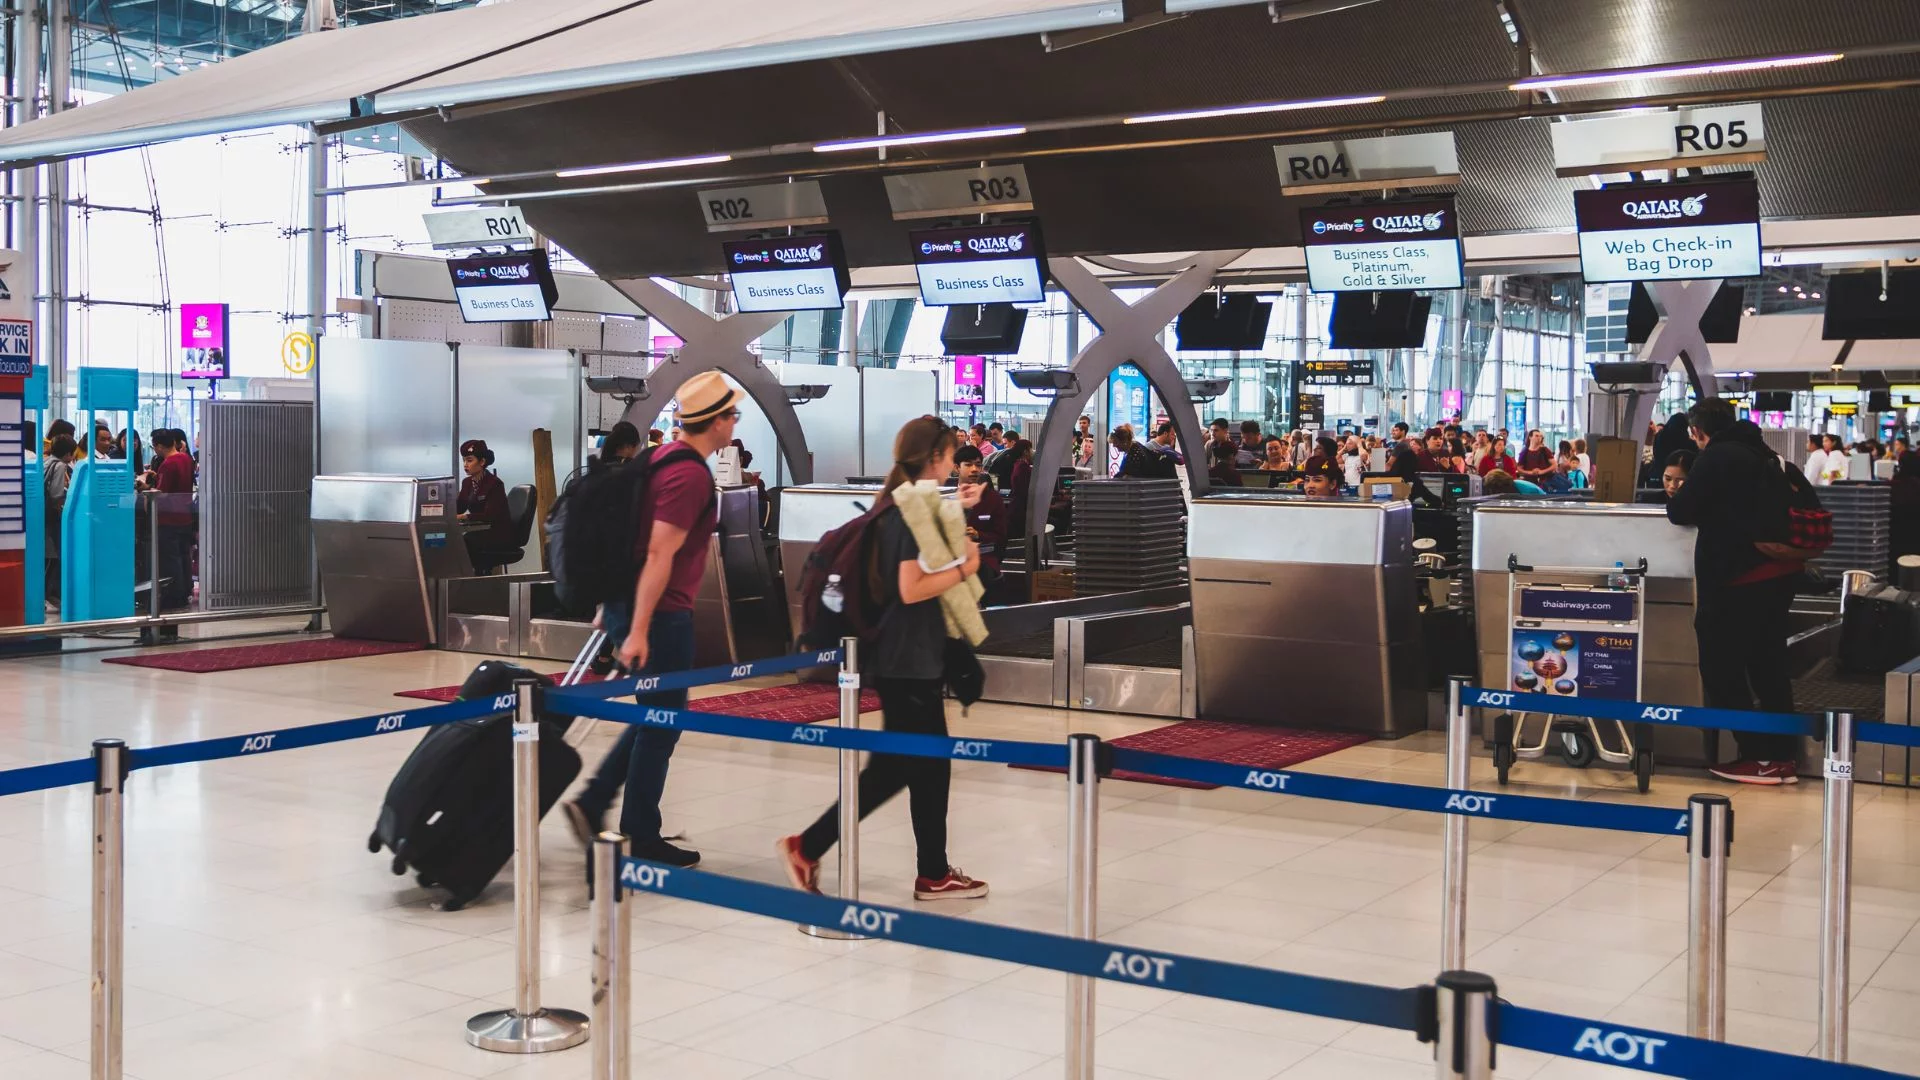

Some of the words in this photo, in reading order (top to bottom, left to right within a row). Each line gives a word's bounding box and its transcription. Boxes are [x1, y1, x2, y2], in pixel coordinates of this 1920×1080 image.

[1674, 119, 1748, 153] R05
[1288, 152, 1350, 182] R04
[968, 176, 1020, 201] R03
[708, 198, 753, 222] R02
[1622, 199, 1681, 217] QATAR
[485, 215, 521, 236] R01
[1326, 222, 1354, 231] Priority
[1372, 215, 1422, 231] QATAR
[932, 244, 953, 252] Priority
[968, 237, 1008, 251] QATAR
[1604, 239, 1646, 254] Web
[1652, 235, 1732, 253] Check-in
[743, 253, 762, 262] Priority
[774, 247, 809, 261] QATAR
[1334, 248, 1389, 260] Business
[1393, 246, 1430, 259] Class,
[490, 265, 519, 277] QATAR
[1352, 262, 1414, 273] Platinum,
[1627, 257, 1661, 273] Bag
[1667, 255, 1713, 272] Drop
[936, 277, 988, 290] Business
[992, 275, 1025, 288] Class
[1343, 275, 1373, 287] Gold
[1377, 275, 1387, 286] &
[1391, 274, 1426, 285] Silver
[748, 285, 794, 298] Business
[797, 283, 825, 295] Class
[471, 298, 509, 309] Business
[511, 297, 535, 308] Class
[15, 338, 29, 354] IN
[1118, 365, 1139, 377] Notice
[1542, 600, 1611, 611] thaiairways.com
[1609, 638, 1633, 646] THAI
[817, 651, 837, 663] AOT
[731, 664, 753, 678] AOT
[636, 677, 660, 691] AOT
[493, 694, 517, 710] AOT
[1477, 691, 1514, 706] AOT
[645, 709, 678, 725] AOT
[1641, 706, 1683, 721] AOT
[376, 714, 405, 732] AOT
[242, 734, 275, 752] AOT
[792, 727, 828, 743] AOT
[953, 741, 992, 757] AOT
[1245, 771, 1290, 790] AOT
[1445, 794, 1496, 814] AOT
[621, 862, 671, 888] AOT
[840, 905, 899, 934] AOT
[1103, 951, 1174, 983] AOT
[1574, 1028, 1667, 1066] AOT
